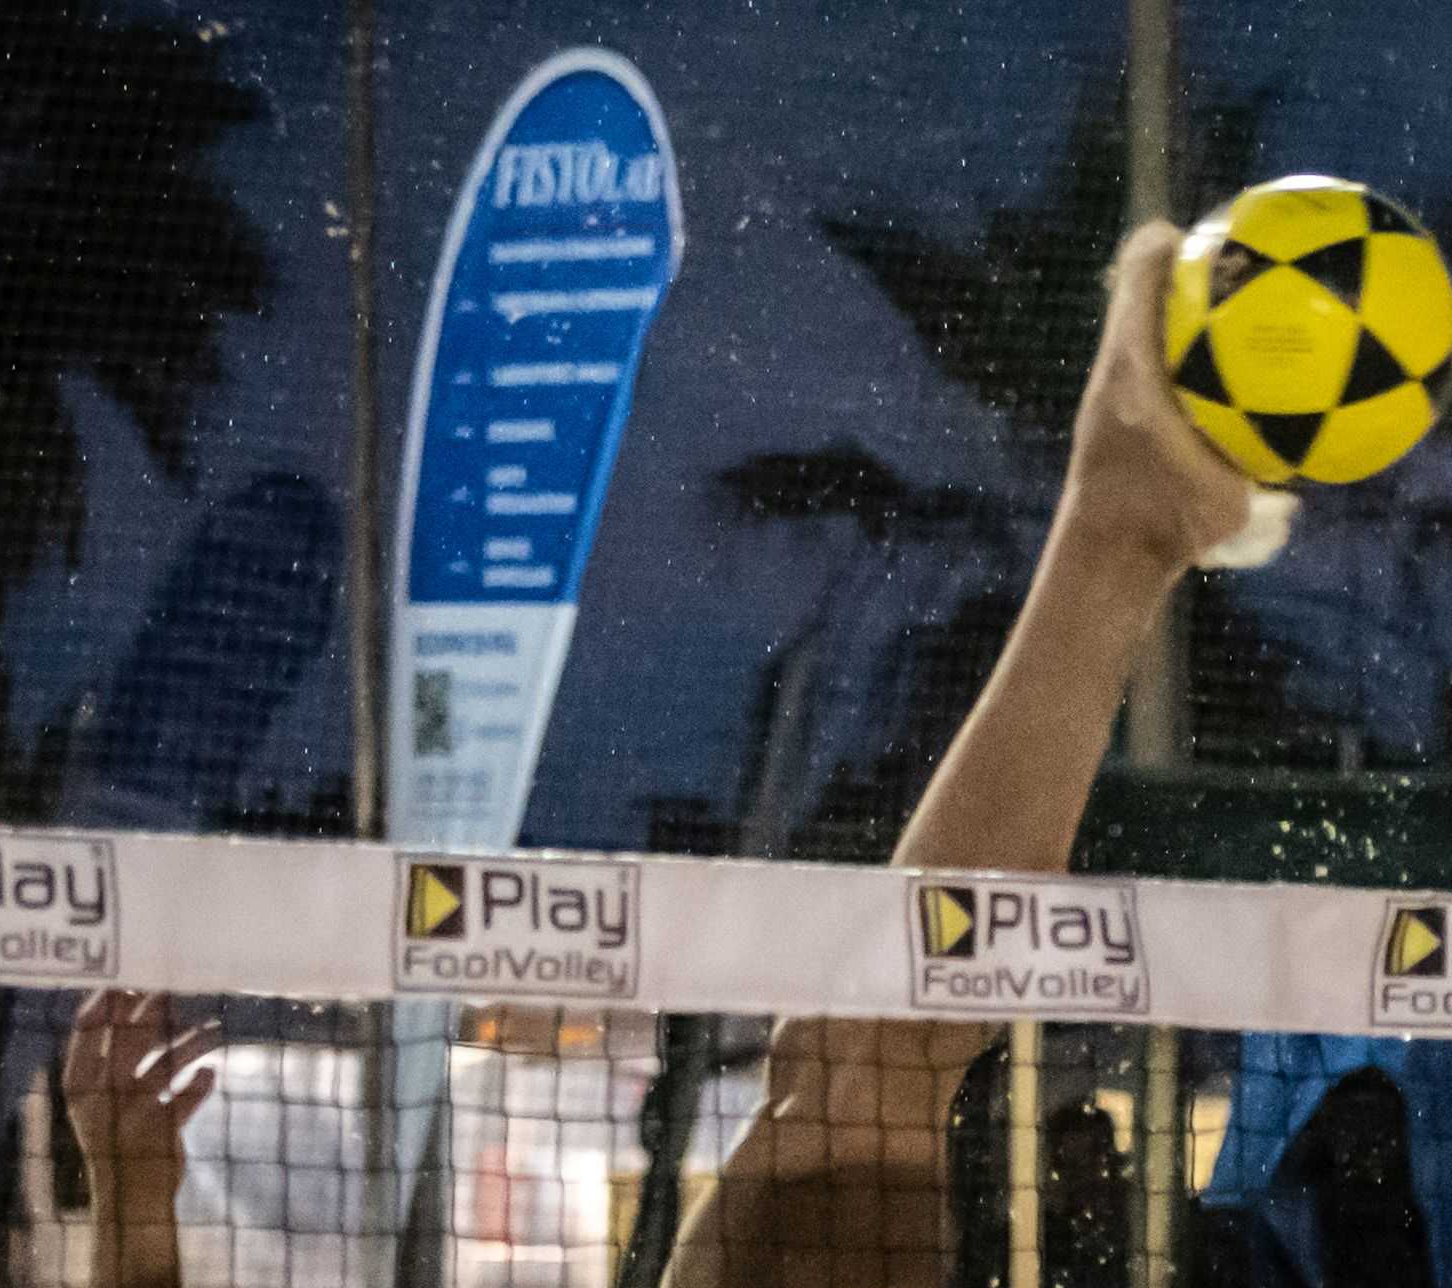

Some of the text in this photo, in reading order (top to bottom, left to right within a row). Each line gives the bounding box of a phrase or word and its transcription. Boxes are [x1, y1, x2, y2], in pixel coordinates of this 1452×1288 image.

[481, 869, 629, 949] Play
[986, 892, 1135, 965] Play
[402, 945, 629, 992] FootVolley
[923, 964, 1140, 1010] FootVolley
